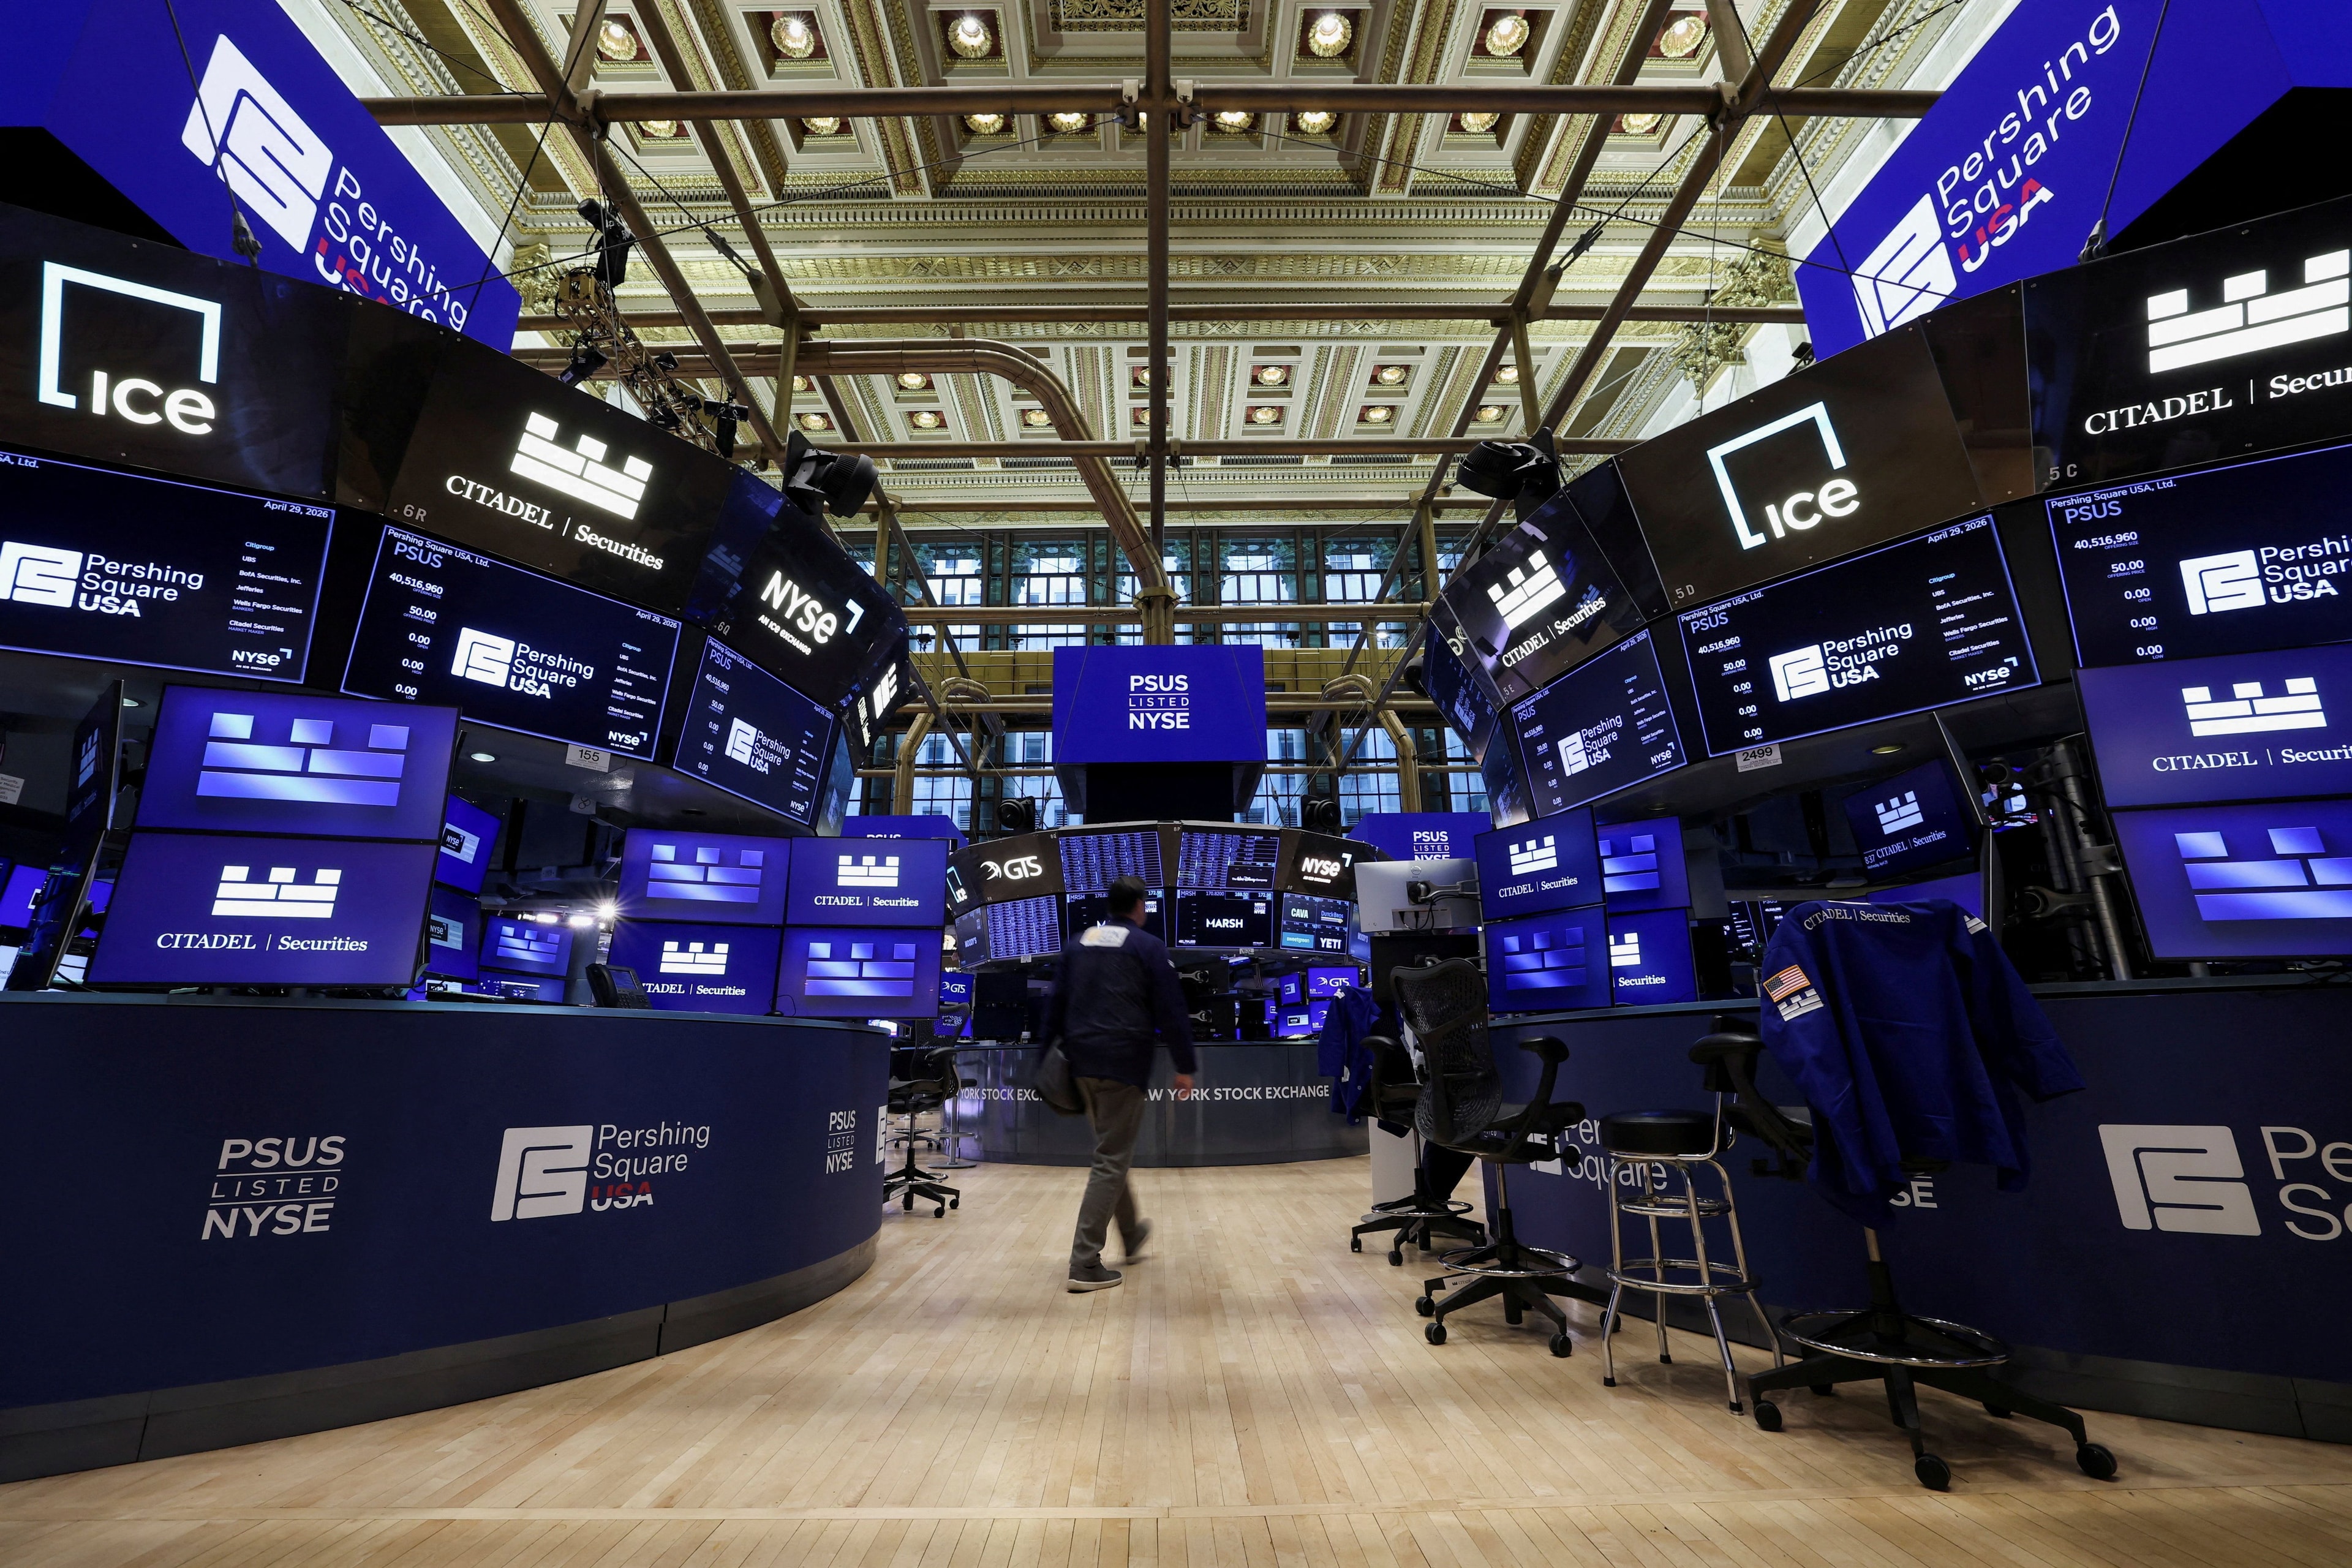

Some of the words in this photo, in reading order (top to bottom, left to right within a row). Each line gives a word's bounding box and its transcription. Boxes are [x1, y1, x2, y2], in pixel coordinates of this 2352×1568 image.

[1937, 4, 2120, 208] Pershing
[1947, 86, 2092, 238] Square
[1961, 178, 2054, 273] USA
[334, 167, 467, 332] Pershing
[315, 237, 388, 305] US
[2084, 387, 2233, 435] CITADEL
[17, 458, 39, 469] Ltd.
[2051, 496, 2092, 508] Pershing
[2094, 490, 2128, 500] Square
[2130, 484, 2154, 494] USA,
[2157, 480, 2176, 489] Ltd.
[264, 501, 287, 511] April
[289, 505, 303, 514] 29,
[306, 508, 328, 518] 2026
[403, 505, 427, 522] 6R
[2065, 500, 2122, 524] PSUS
[446, 475, 553, 529] CITADEL
[575, 525, 665, 570] Securities
[1928, 531, 1948, 543] April
[1949, 527, 1963, 537] 29,
[1965, 519, 1987, 532] 2026
[245, 541, 274, 551] Citigroup
[388, 529, 423, 547] Pershing
[425, 541, 453, 556] Square
[454, 551, 473, 563] USA,
[475, 557, 489, 568] Ltd.
[2075, 531, 2138, 549] 40,516,960
[394, 541, 443, 568] PSUS
[2260, 535, 2352, 565] Pershi
[86, 554, 203, 590] Pershing
[2111, 560, 2144, 573] 50.00
[2264, 559, 2352, 582] Squar
[257, 573, 289, 582] Securities,
[389, 573, 443, 595] 40,516,960
[1929, 573, 1955, 584] Citigroup
[81, 573, 178, 602] Square
[2124, 588, 2150, 600] 0.00
[2269, 579, 2339, 603] USA
[78, 592, 141, 617] USA
[272, 605, 303, 613] Securities
[1681, 609, 1708, 622] Pershing
[1709, 601, 1732, 612] Square
[1732, 596, 1749, 606] USA,
[1750, 591, 1764, 600] Ltd.
[1951, 595, 1982, 606] Securities,
[409, 606, 437, 620] 50.00
[636, 611, 651, 620] April
[652, 616, 661, 624] 29,
[662, 619, 677, 628] 2026
[1940, 614, 1965, 624] Jefferies
[2130, 616, 2157, 628] 0.00
[253, 623, 284, 632] Securities
[1691, 612, 1728, 634] PSUS
[1978, 617, 2008, 628] Securities
[409, 633, 430, 645] 0.00
[1502, 632, 1549, 667] CITADEL
[1555, 597, 1606, 635] Securities
[1823, 623, 1912, 657] Pershing
[1698, 636, 1740, 654] 40,516,960
[1948, 647, 1970, 656] Citadel
[1970, 640, 2000, 651] Securities
[2136, 644, 2163, 656] 0.00
[402, 658, 424, 670] 0.00
[516, 643, 594, 679] Pershing
[709, 649, 732, 670] PSUS
[1724, 659, 1746, 671] 50.00
[1826, 644, 1899, 671] Square
[513, 658, 576, 687] Square
[1831, 665, 1880, 688] USA
[395, 684, 417, 696] 0.00
[510, 675, 551, 699] USA
[706, 673, 729, 691] 40,516,960
[1129, 675, 1188, 692] PSUS
[1733, 682, 1751, 693] 0.00
[711, 699, 724, 711] 50.00
[1129, 697, 1189, 707] LISTED
[1738, 704, 1757, 715] 0.00
[1129, 712, 1190, 729] NYSE
[1518, 706, 1536, 723] PSUS
[709, 722, 718, 731] 0.00
[1581, 715, 1623, 741] Pershing
[1744, 728, 1762, 738] 0.00
[703, 742, 714, 752] 0.00
[756, 730, 791, 760] Pershing
[1585, 731, 1618, 753] Square
[579, 749, 600, 762] 155
[753, 742, 782, 766] Square
[1588, 748, 1611, 766] USA
[1742, 747, 1773, 762] 2499
[2152, 751, 2258, 772] CITADEL
[698, 762, 709, 772] 0.00
[750, 756, 769, 775] USA
[1413, 831, 1449, 842] PSUS
[1864, 854, 1875, 864] 8:37
[1876, 842, 1908, 858] CITADEL
[1912, 830, 1947, 847] Securities
[1004, 856, 1042, 880] GTS
[1498, 883, 1534, 899] CITADEL
[1540, 875, 1578, 891] Securities
[814, 896, 863, 907] CITADEL
[873, 896, 919, 908] Securities
[1291, 908, 1309, 919] CAVA
[1804, 908, 1852, 930] CITADEL
[1860, 910, 1910, 923] Securities
[1206, 918, 1243, 928] MARSH
[156, 933, 257, 951] CITADEL
[277, 935, 368, 952] Securities
[1320, 938, 1342, 949] YETI
[643, 983, 685, 993] TADEL
[696, 985, 746, 996] Securities
[1618, 974, 1666, 987] Securities
[960, 1088, 980, 1100] YORK
[981, 1088, 1014, 1101] STOCK
[1167, 1088, 1210, 1101] YORK
[1214, 1087, 1262, 1101] STOCK
[1265, 1085, 1330, 1099] EXCHANGE
[829, 1110, 856, 1131] PSUS
[598, 1121, 710, 1150] Pershing
[827, 1135, 855, 1149] LISTED
[218, 1136, 346, 1170] PSUS
[593, 1152, 687, 1182] Square
[826, 1152, 853, 1174] NYSE
[211, 1177, 339, 1199] LISTED
[590, 1182, 654, 1212] USA
[201, 1202, 334, 1240] NYSE
